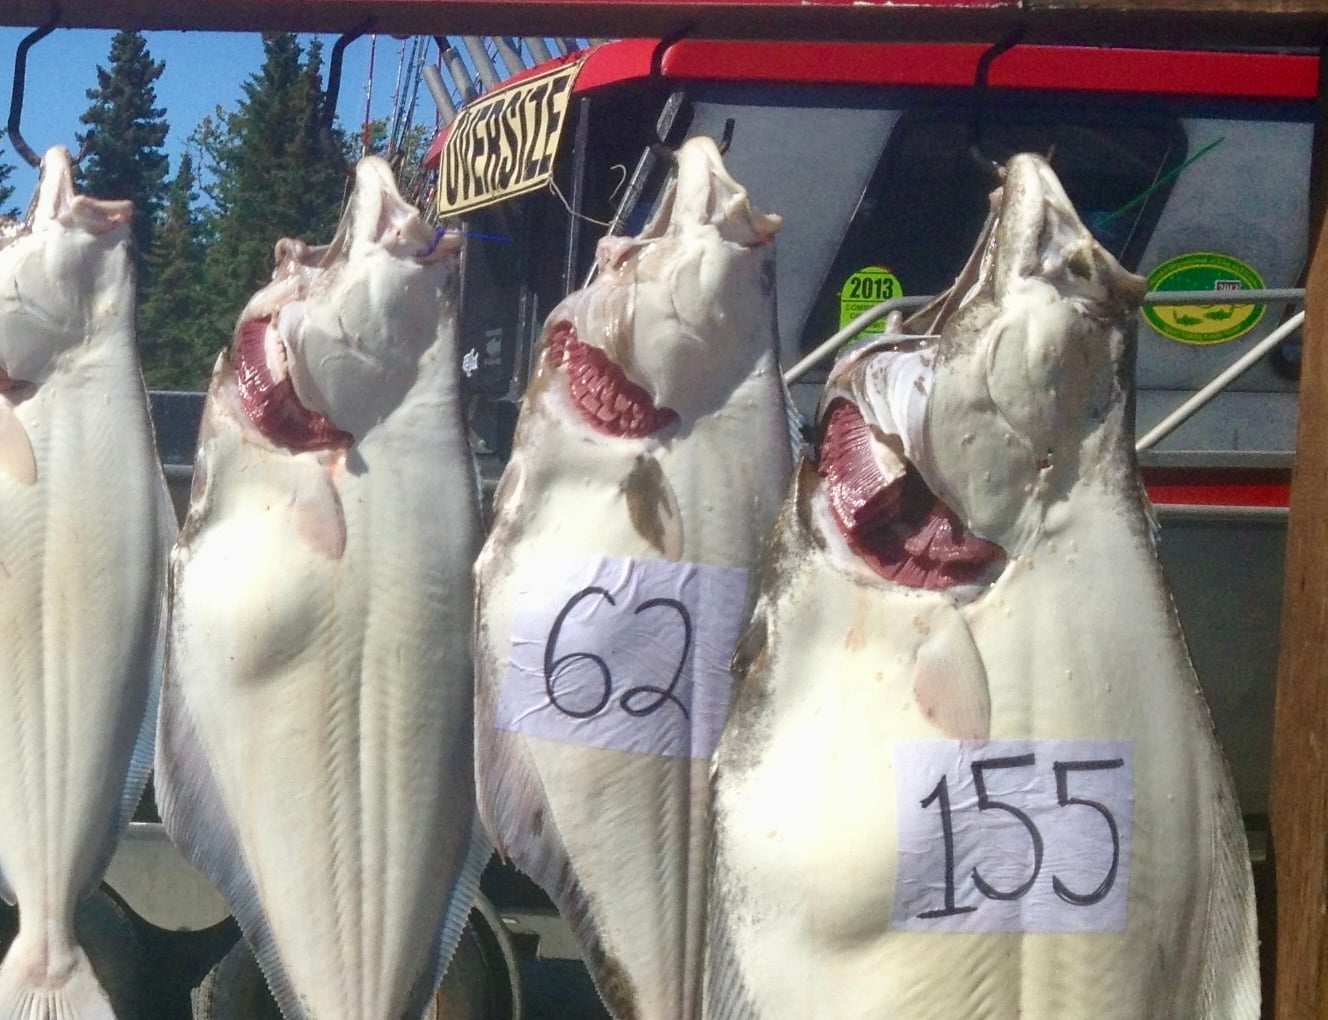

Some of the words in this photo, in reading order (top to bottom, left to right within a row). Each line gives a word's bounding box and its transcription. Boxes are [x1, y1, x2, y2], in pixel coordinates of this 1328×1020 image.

[446, 75, 570, 205] OVERSIZE
[850, 277, 893, 299] 2013
[545, 586, 690, 719] 62
[916, 753, 1125, 918] 155
